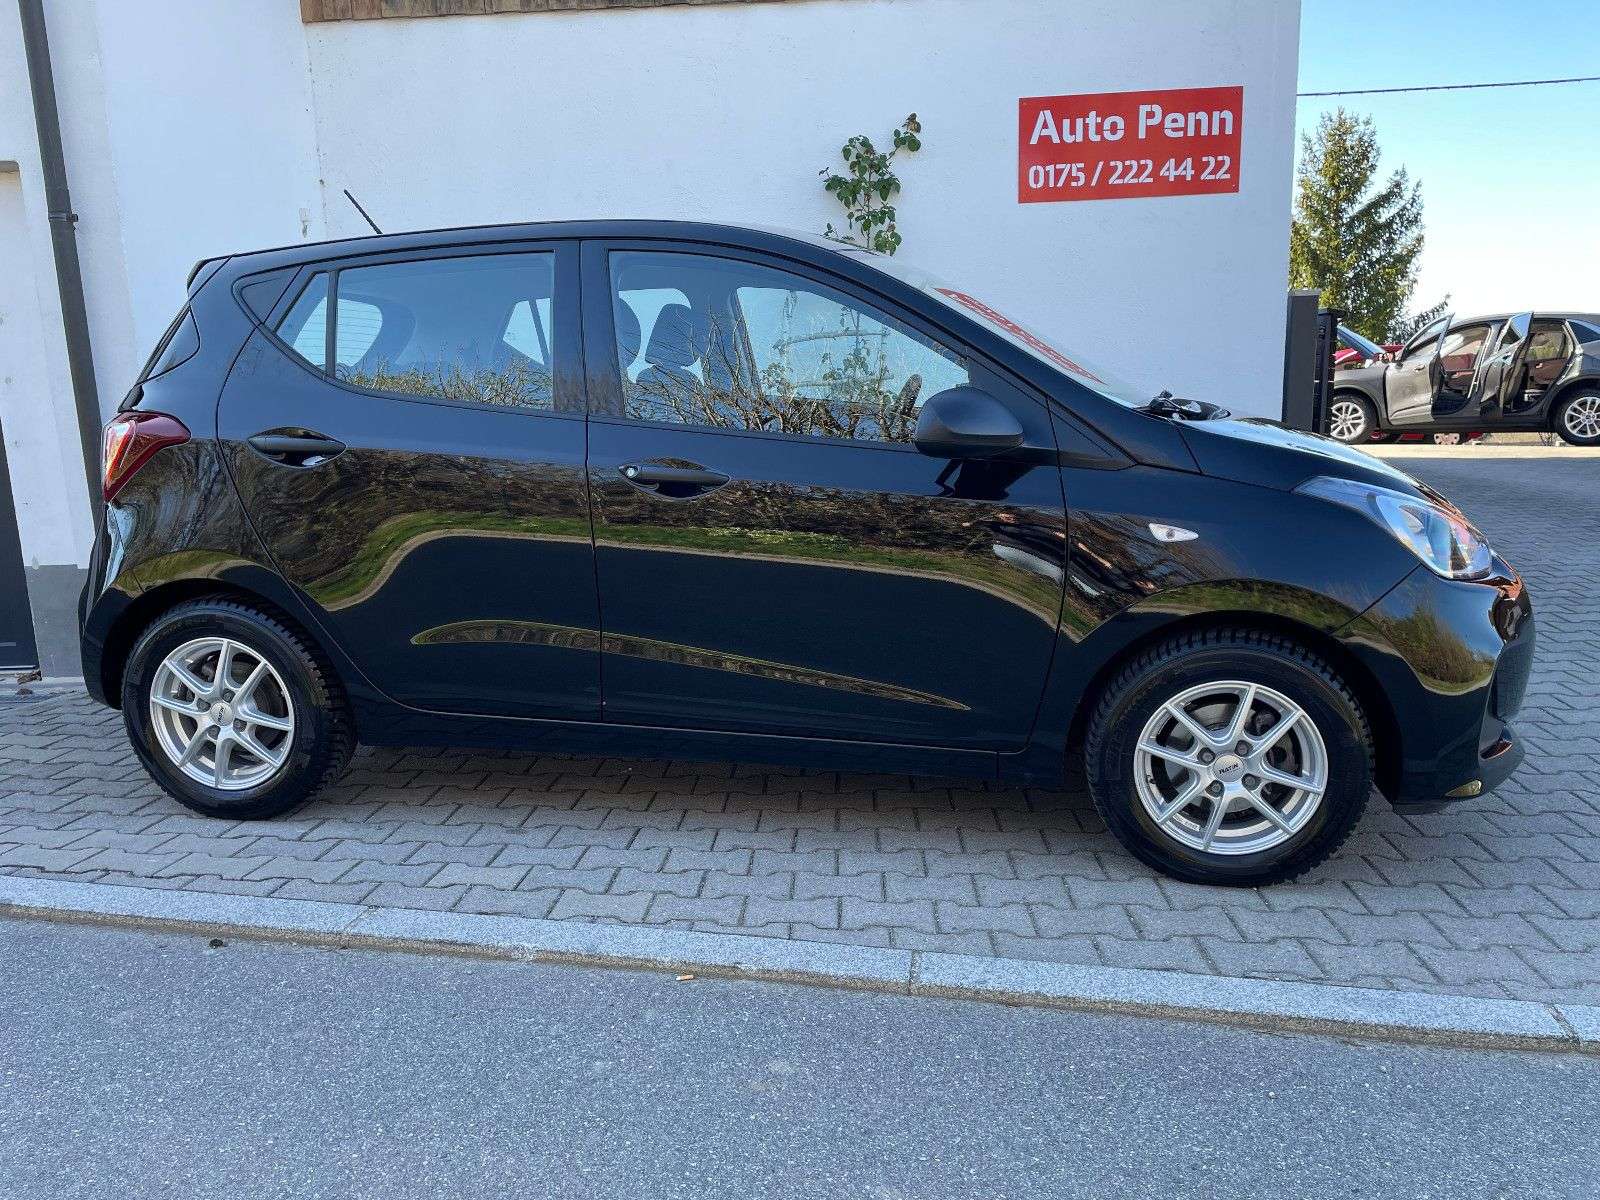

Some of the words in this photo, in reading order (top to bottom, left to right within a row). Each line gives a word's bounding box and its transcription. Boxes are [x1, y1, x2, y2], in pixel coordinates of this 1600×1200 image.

[1030, 109, 1125, 145] Auto
[1138, 104, 1233, 140] Penn
[1028, 162, 1086, 189] 0175
[1091, 160, 1104, 187] /
[1108, 159, 1153, 185] 222
[1159, 157, 1194, 182] 44
[1200, 155, 1231, 181] 22
